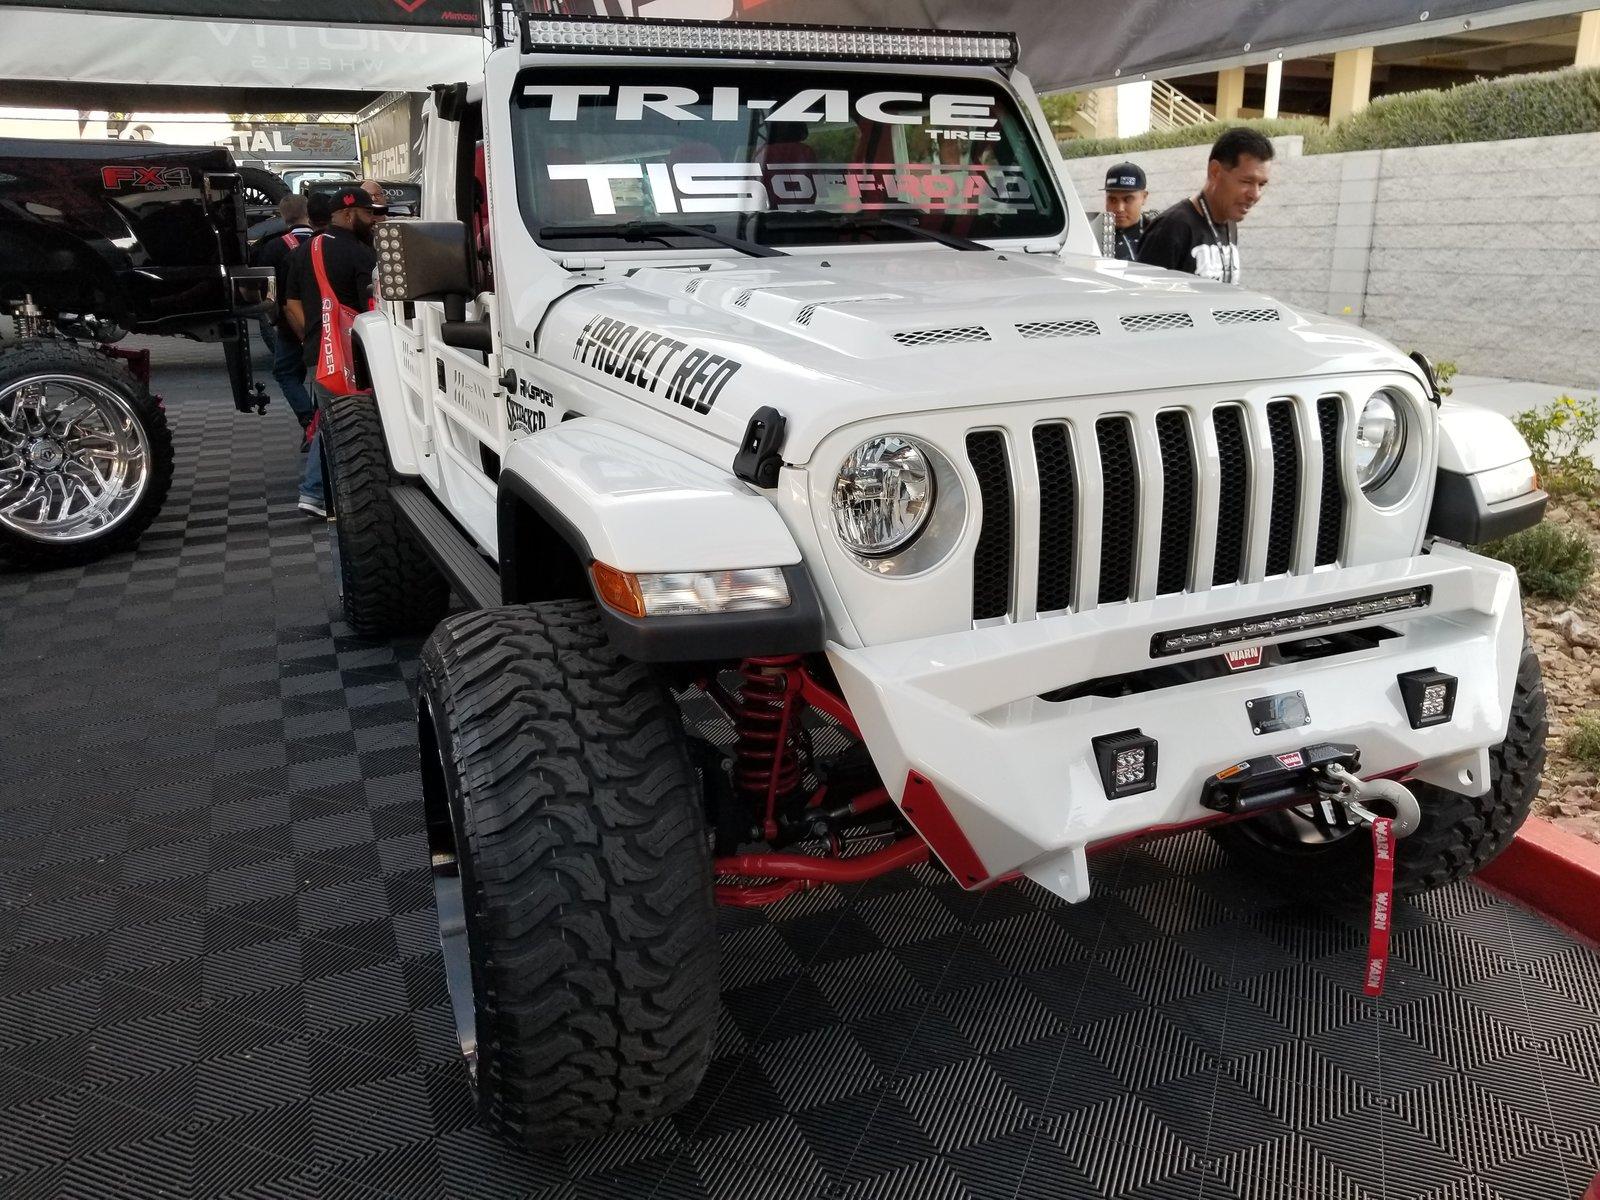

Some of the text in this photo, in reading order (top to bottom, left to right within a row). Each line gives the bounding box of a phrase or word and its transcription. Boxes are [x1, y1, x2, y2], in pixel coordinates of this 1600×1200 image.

[523, 85, 998, 128] TRI-ACE
[924, 130, 1001, 141] TIRES
[101, 166, 192, 189] FX4
[547, 163, 769, 216] TIS
[322, 313, 335, 375] SPYDER
[664, 348, 741, 415] RED
[1229, 647, 1259, 661] WARN
[1283, 756, 1300, 766] WARN
[1375, 820, 1390, 860] WARN
[1374, 892, 1389, 931] WARN
[1367, 958, 1384, 989] WARN
